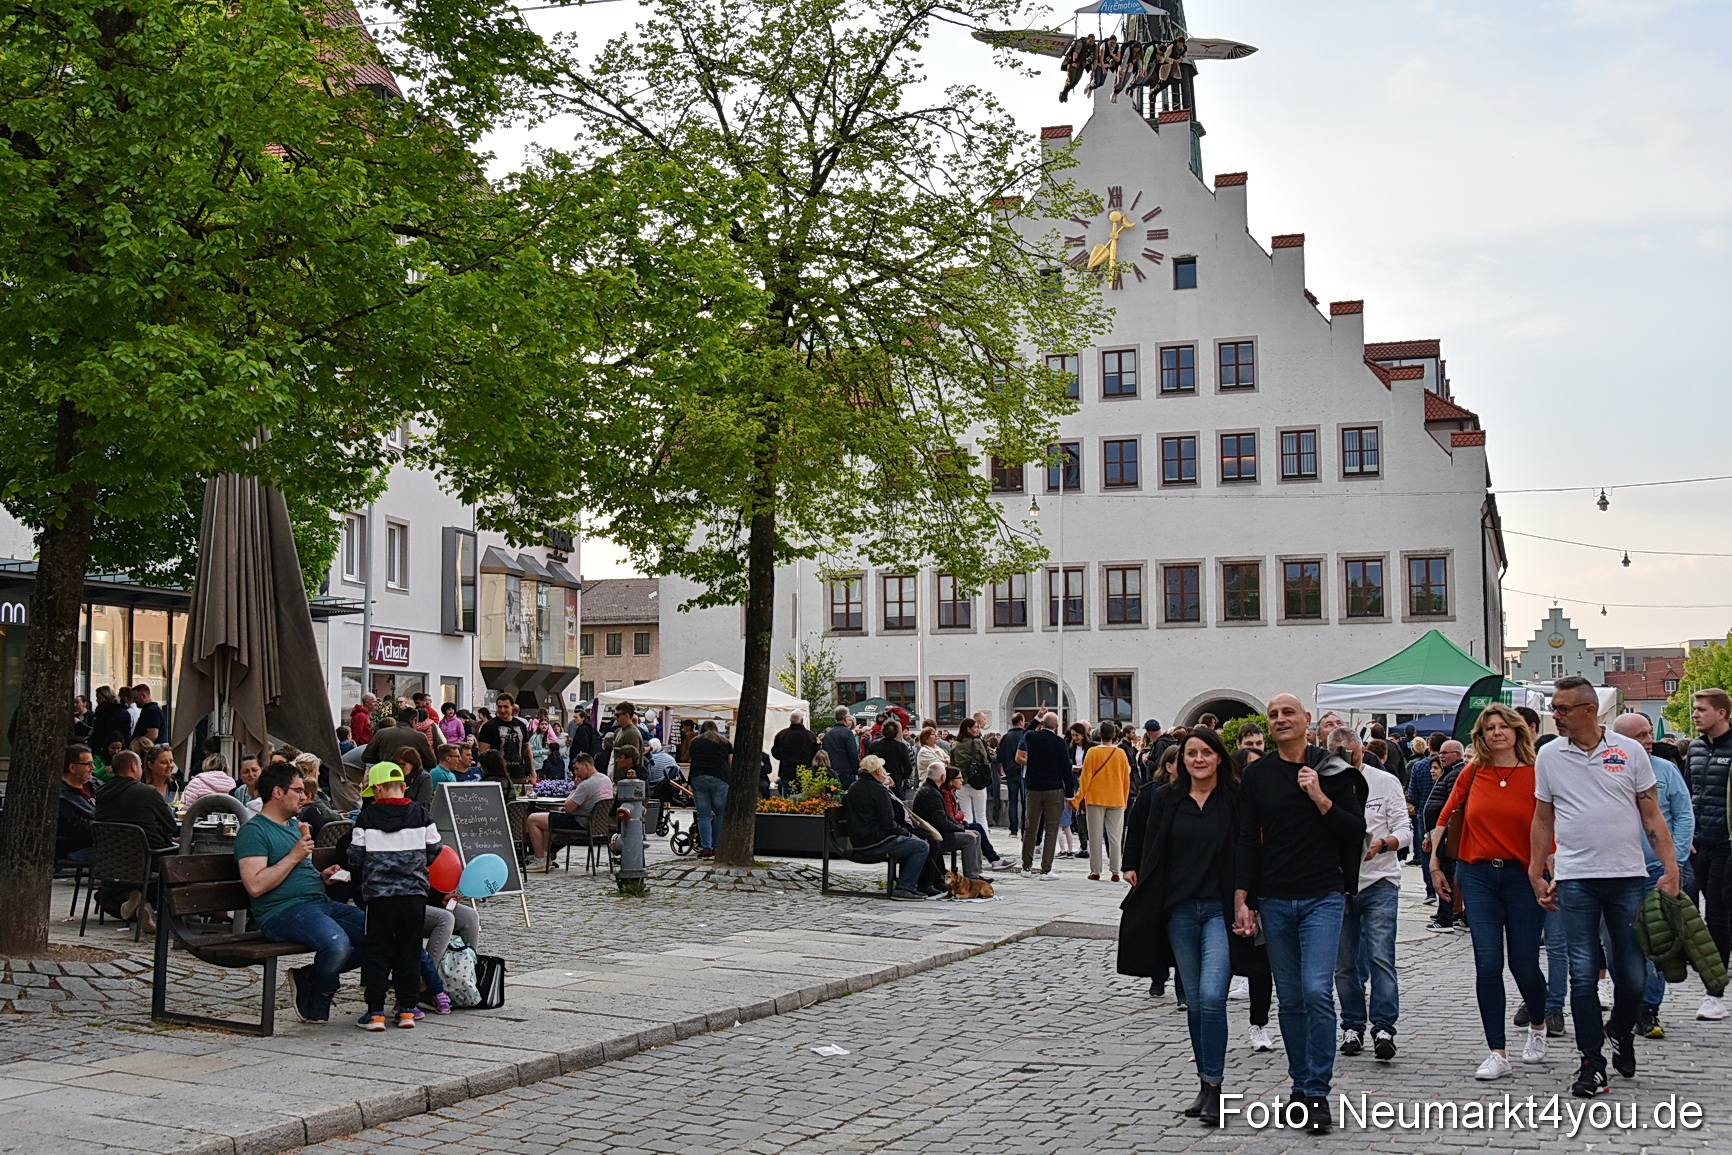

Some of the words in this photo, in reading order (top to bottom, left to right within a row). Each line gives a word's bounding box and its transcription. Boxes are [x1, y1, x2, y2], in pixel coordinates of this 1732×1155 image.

[1100, 1, 1140, 11] AirEmotion
[375, 635, 409, 661] Achatz
[455, 814, 488, 825] Bezahlung
